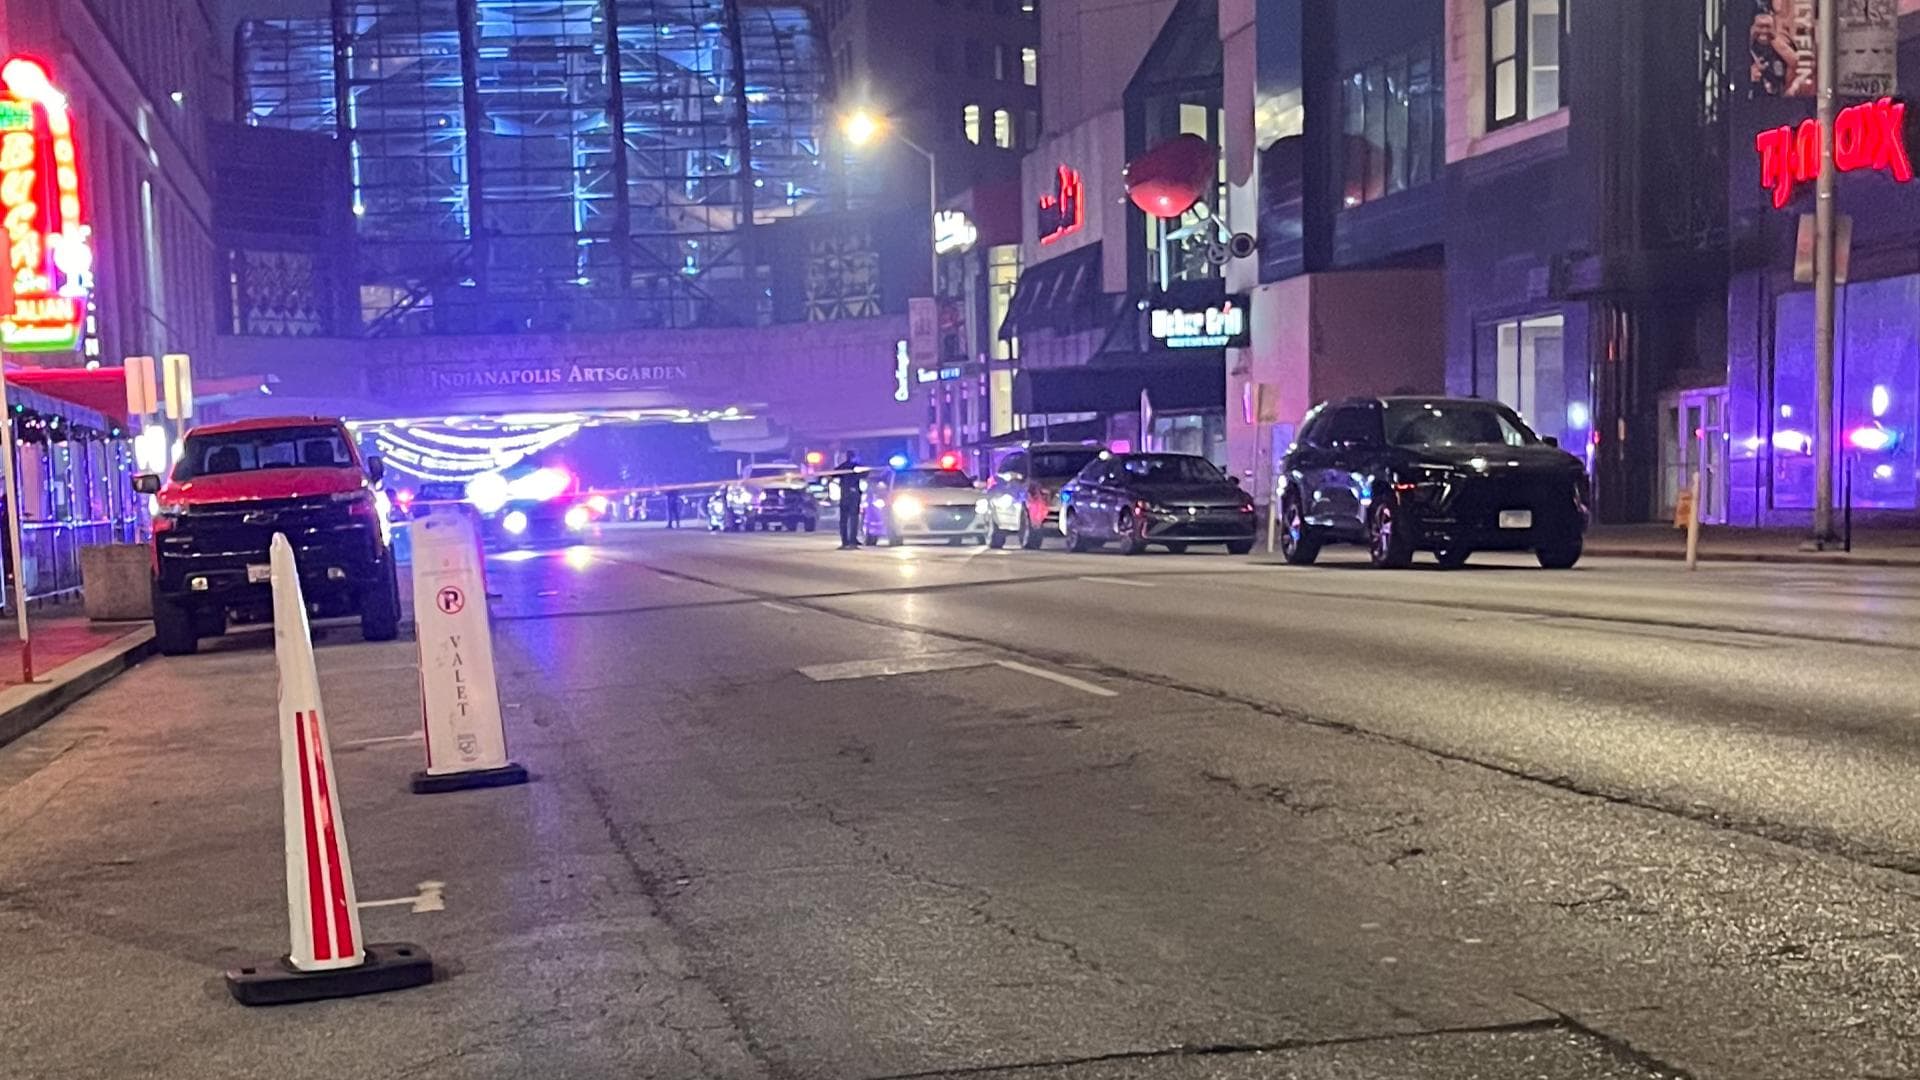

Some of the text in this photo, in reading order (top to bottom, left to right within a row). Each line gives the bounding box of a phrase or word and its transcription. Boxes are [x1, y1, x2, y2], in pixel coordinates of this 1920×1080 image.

[432, 365, 687, 387] INDIANAPOLIS ARTSGARDEN
[450, 635, 469, 717] VALET
